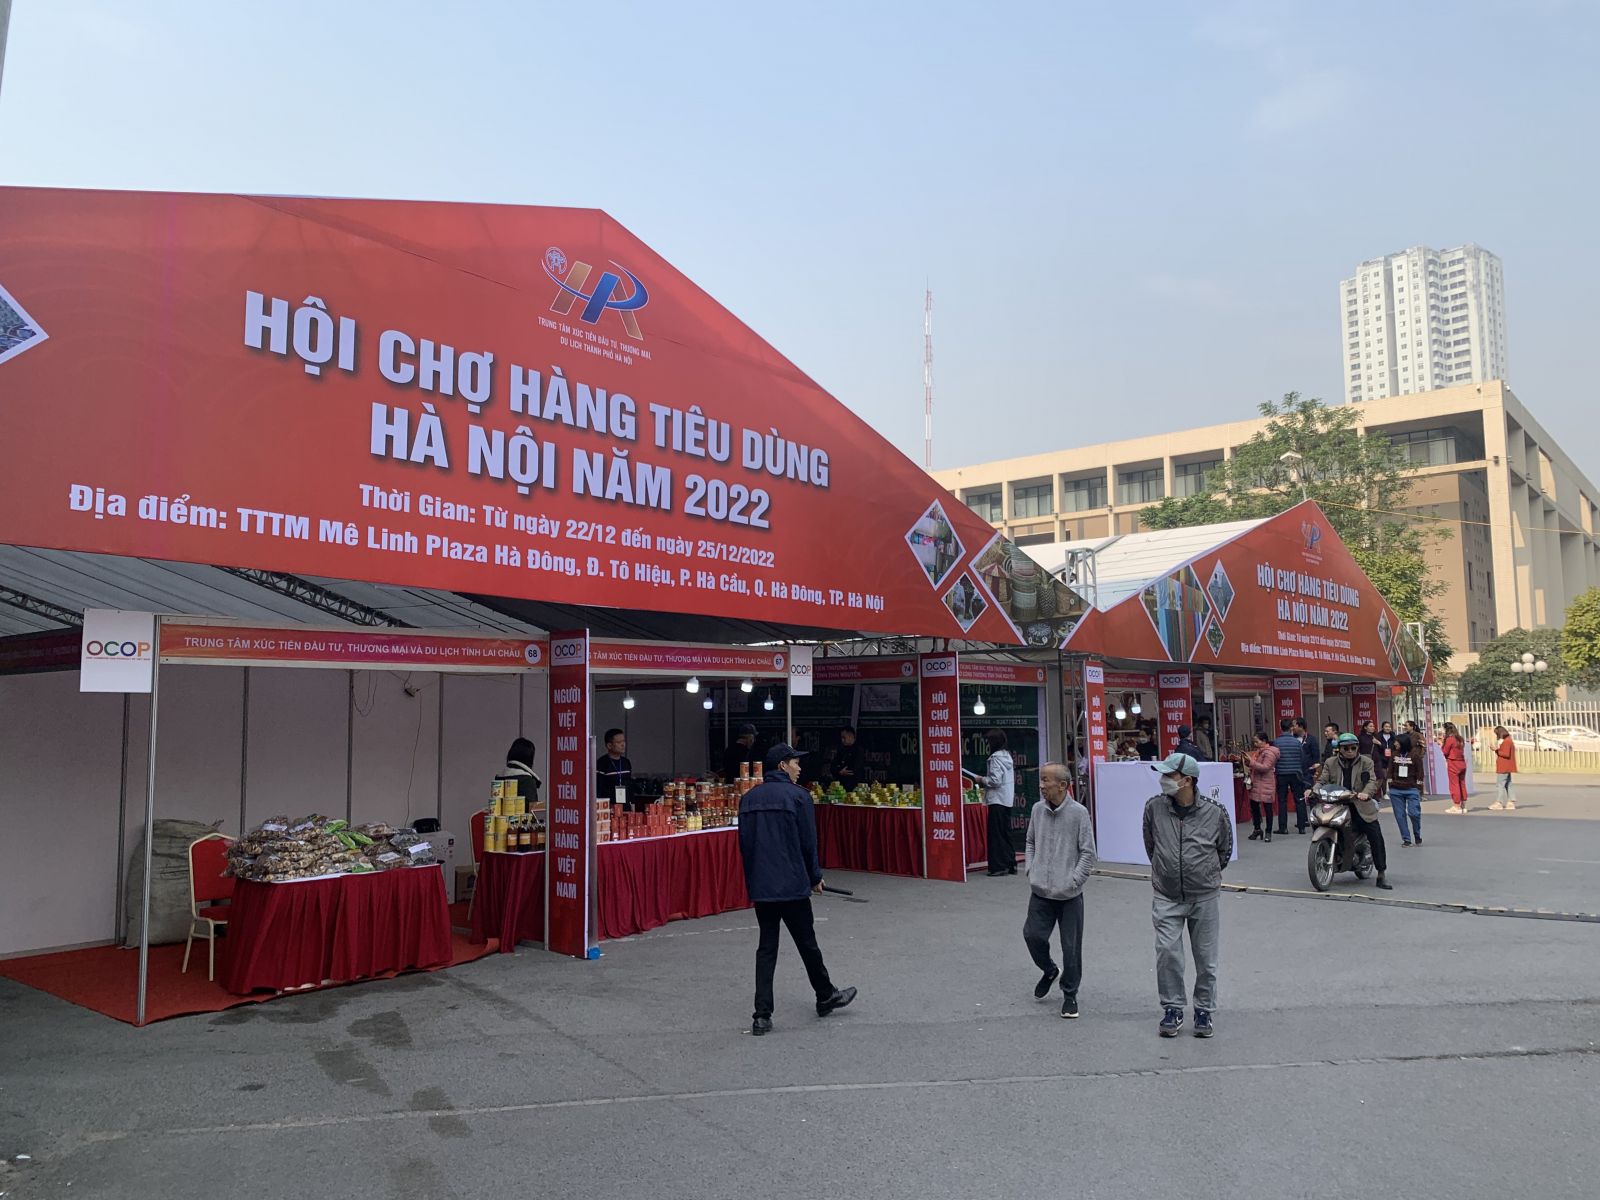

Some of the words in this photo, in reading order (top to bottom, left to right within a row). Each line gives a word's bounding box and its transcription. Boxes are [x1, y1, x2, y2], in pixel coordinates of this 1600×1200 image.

[538, 316, 557, 330] TRUNG
[244, 290, 356, 376] HỘI
[378, 329, 494, 414] CHỢ
[509, 363, 636, 441] HÀNG
[649, 402, 730, 462] TIÊU
[742, 426, 829, 487] DÙNG
[370, 401, 449, 469] HÀ
[467, 424, 556, 495] NỘI
[572, 446, 671, 511] NĂM
[683, 474, 770, 529] 2022
[359, 483, 411, 513] Thời
[418, 493, 476, 524] Gian:
[482, 504, 509, 529] Từ
[513, 513, 561, 538] ngày
[565, 519, 617, 545] 22/12
[621, 526, 652, 550] đến
[656, 534, 694, 558] ngày
[697, 538, 776, 568] 25/12/2022
[68, 483, 127, 520] Địa
[138, 493, 227, 530] điểm:
[236, 507, 310, 541] TTTM
[318, 519, 359, 547] Mê
[367, 526, 419, 555] Linh
[426, 533, 489, 563] Plaza
[494, 544, 521, 568] Hà
[526, 549, 581, 578] Đông,
[587, 556, 605, 578] Đ.
[609, 559, 630, 580] Tô
[634, 562, 676, 588] Hiệu,
[679, 568, 692, 588] P.
[696, 569, 716, 590] Hà
[719, 572, 750, 596] Cầu,
[754, 578, 768, 598] Q.
[771, 580, 788, 600] Hà
[791, 583, 826, 607] Đông,
[829, 589, 845, 607] TP.
[848, 591, 863, 609] Hà
[865, 593, 885, 613] Nội
[1256, 561, 1275, 595] HỘI
[1277, 568, 1296, 598] CHỢ
[1298, 570, 1321, 598] HÀNG
[1322, 577, 1339, 603] TIÊU
[1340, 580, 1360, 609] DÙNG
[1277, 595, 1291, 621] HÀ
[1292, 598, 1308, 628] NỘI
[1310, 602, 1330, 627] NĂM
[1330, 609, 1349, 631] 2022
[86, 640, 151, 657] OCOP
[184, 637, 225, 649] TRUNG
[227, 637, 251, 650] TÂM
[253, 637, 276, 650] XÚC
[278, 638, 302, 651] TIẾN
[303, 638, 325, 652] ĐẦU
[328, 642, 345, 653] TƯ,
[347, 643, 390, 654] THƯƠNG
[391, 645, 409, 657] MẠI
[410, 644, 423, 655] VÀ
[425, 646, 438, 656] DU
[439, 646, 460, 658] LỊCH
[462, 645, 481, 657] TỈNH
[482, 648, 496, 657] LAI
[527, 649, 538, 658] 68
[554, 643, 582, 657] OCOP
[593, 650, 608, 661] TÂM
[609, 650, 623, 662] XÚC
[665, 653, 692, 664] THƯƠNG
[692, 655, 703, 665] MẠI
[703, 654, 712, 664] VÀ
[712, 656, 721, 665] DU
[721, 656, 734, 667] LỊCH
[747, 657, 757, 666] LAI
[775, 657, 783, 666] 67
[925, 661, 953, 672] OCOP
[790, 663, 812, 676] OCOP
[1162, 676, 1186, 684] OCOP
[553, 684, 581, 704] NGƯỜI
[932, 691, 947, 706] HỘI
[1163, 698, 1186, 709] NGƯỜI
[1281, 698, 1293, 708] HỘI
[558, 709, 577, 731] VIỆT
[931, 707, 949, 723] CHỢ
[1167, 711, 1184, 723] VIỆT
[928, 724, 953, 738] HÀNG
[1167, 724, 1179, 733] NA
[557, 736, 578, 752] NAM
[931, 741, 951, 755] TIÊU
[561, 760, 574, 776] ƯU
[929, 758, 954, 772] DÙNG
[936, 774, 949, 789] HÀ
[557, 781, 577, 800] TIÊN
[935, 792, 951, 808] NỘI
[555, 805, 579, 825] DÙNG
[932, 809, 955, 823] NĂM
[555, 829, 579, 850] HÀNG
[933, 828, 955, 841] 2022
[557, 854, 577, 877] VIỆT
[556, 881, 577, 900] NAM
